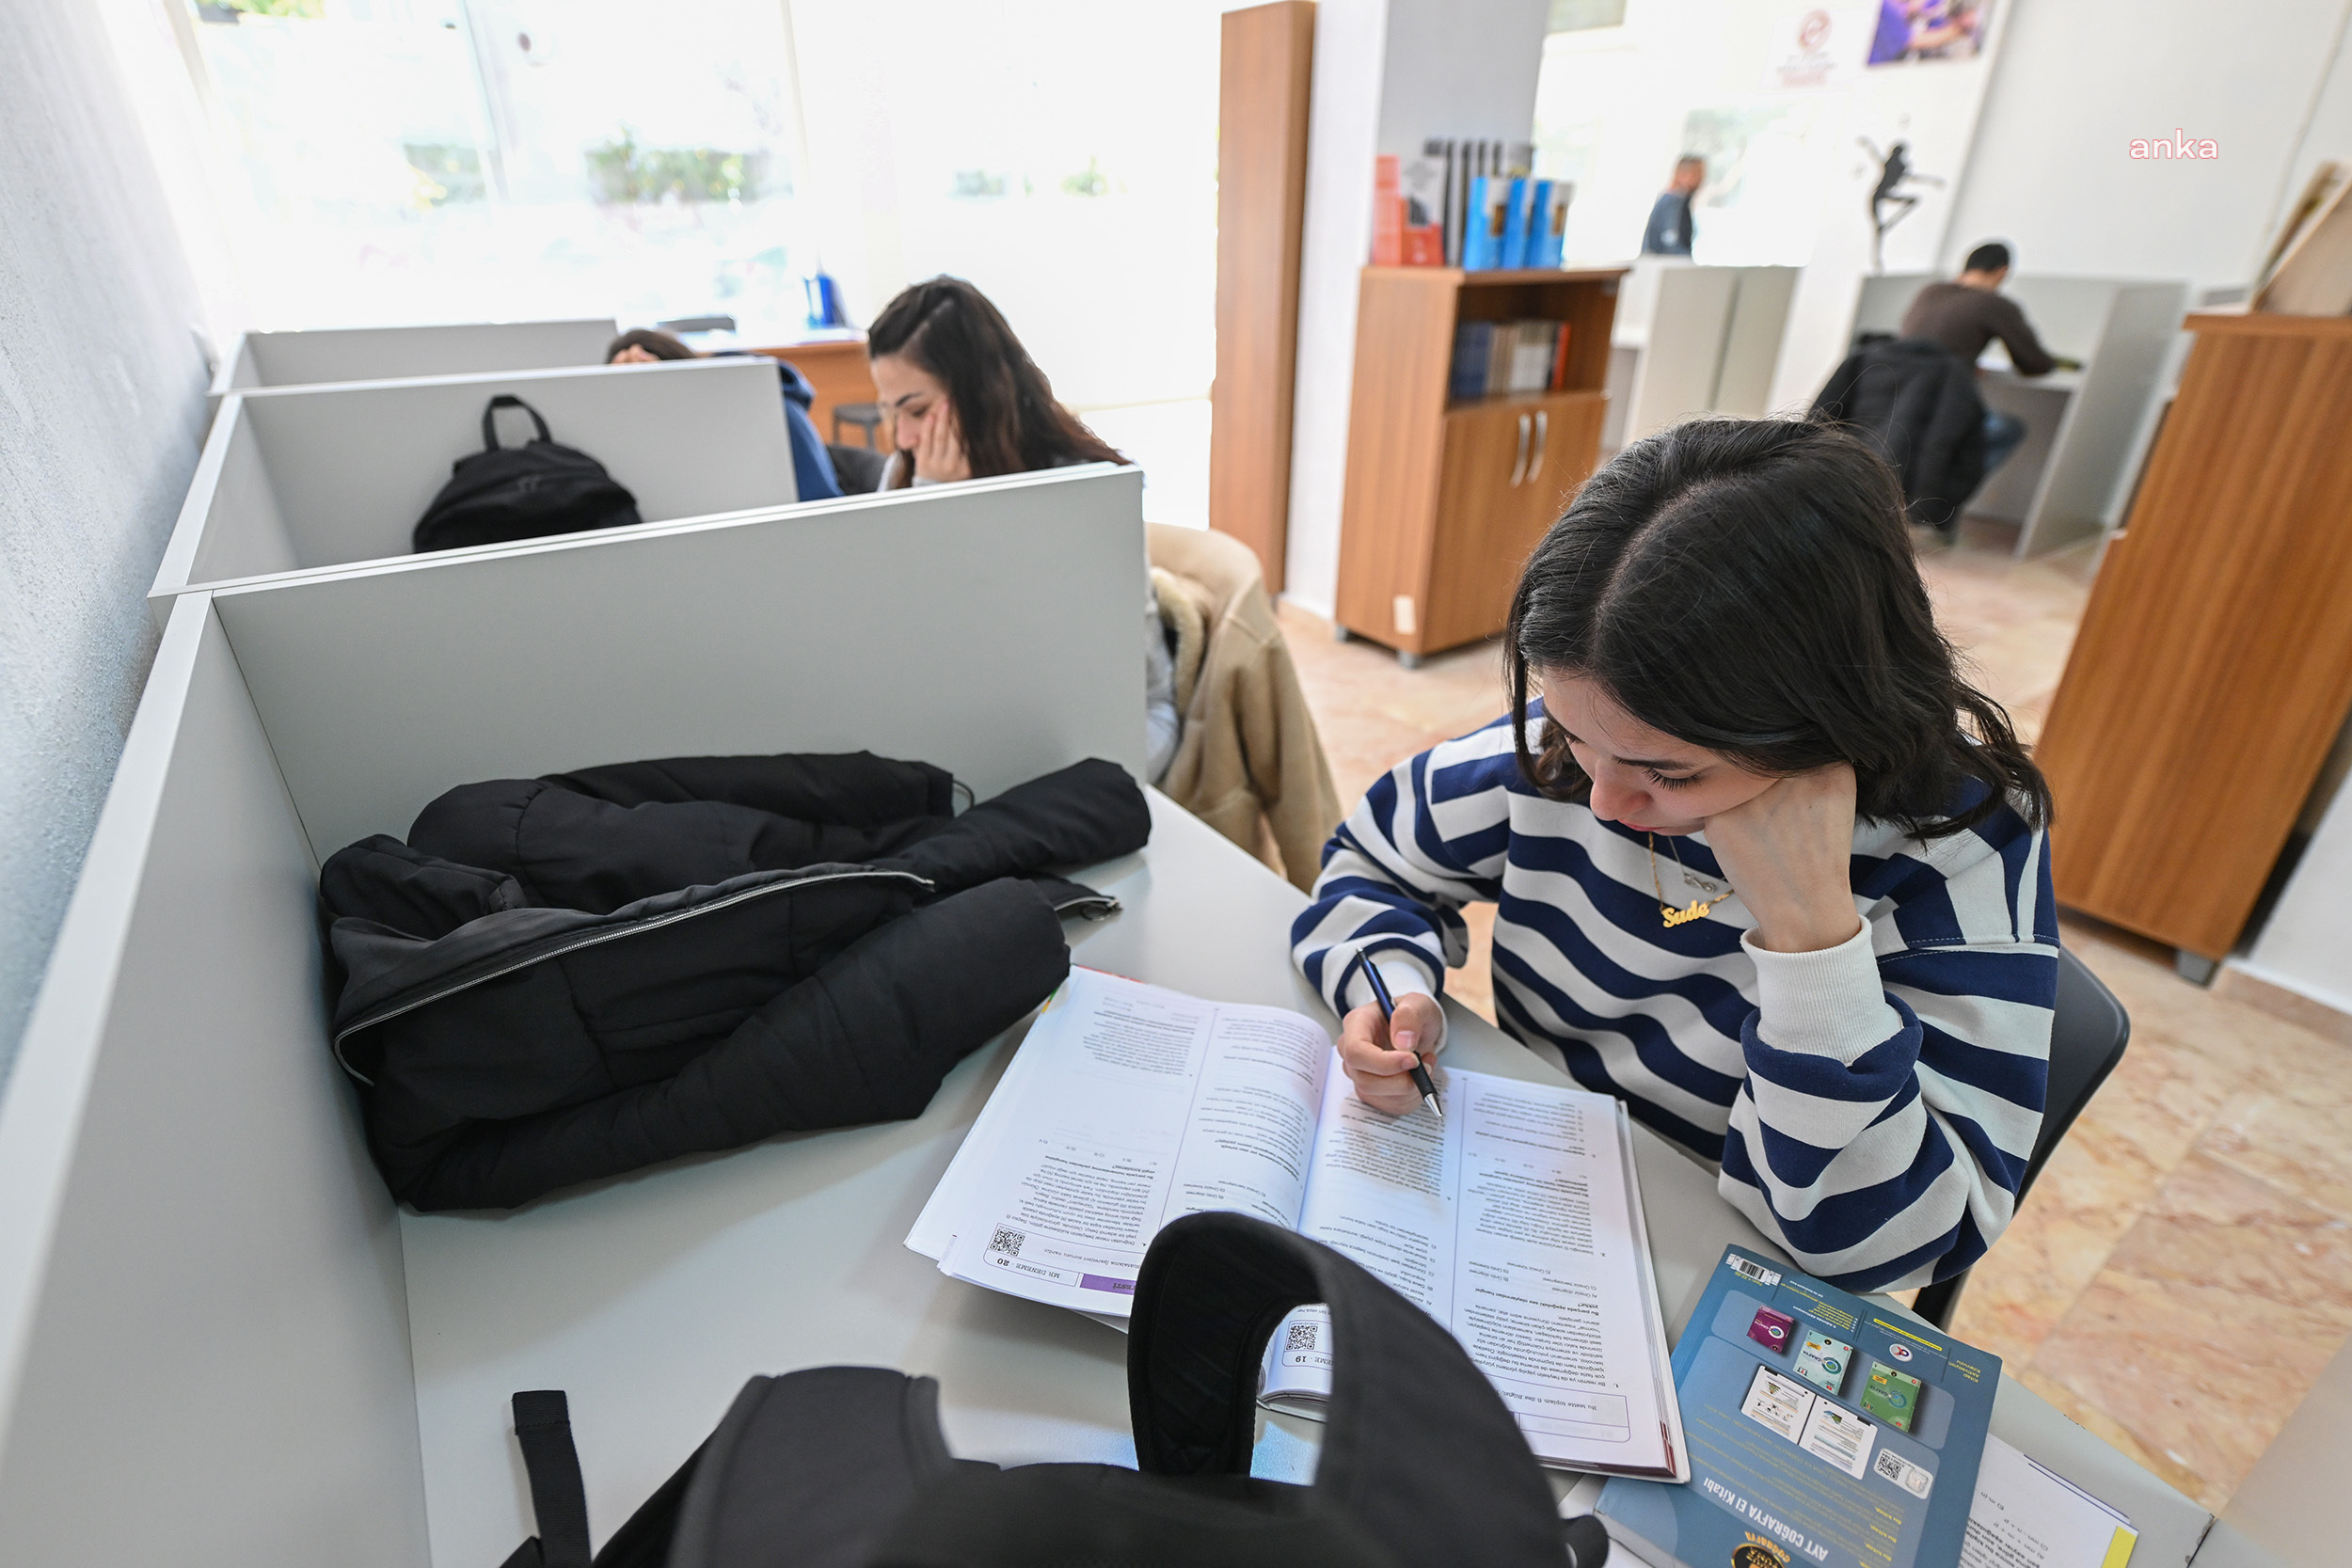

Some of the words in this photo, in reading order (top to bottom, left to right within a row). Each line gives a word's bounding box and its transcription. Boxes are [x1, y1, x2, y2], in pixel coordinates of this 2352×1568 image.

[1661, 899, 1710, 928] Sude
[996, 1258, 1009, 1266] 20
[1015, 1263, 1046, 1275] DENEME
[1703, 1477, 1735, 1505] Kitabı
[1735, 1497, 1747, 1513] El
[1747, 1504, 1804, 1547] COĞRAFYA
[1744, 1530, 1790, 1562] COĞRAFYA
[1804, 1539, 1828, 1561] AYT
